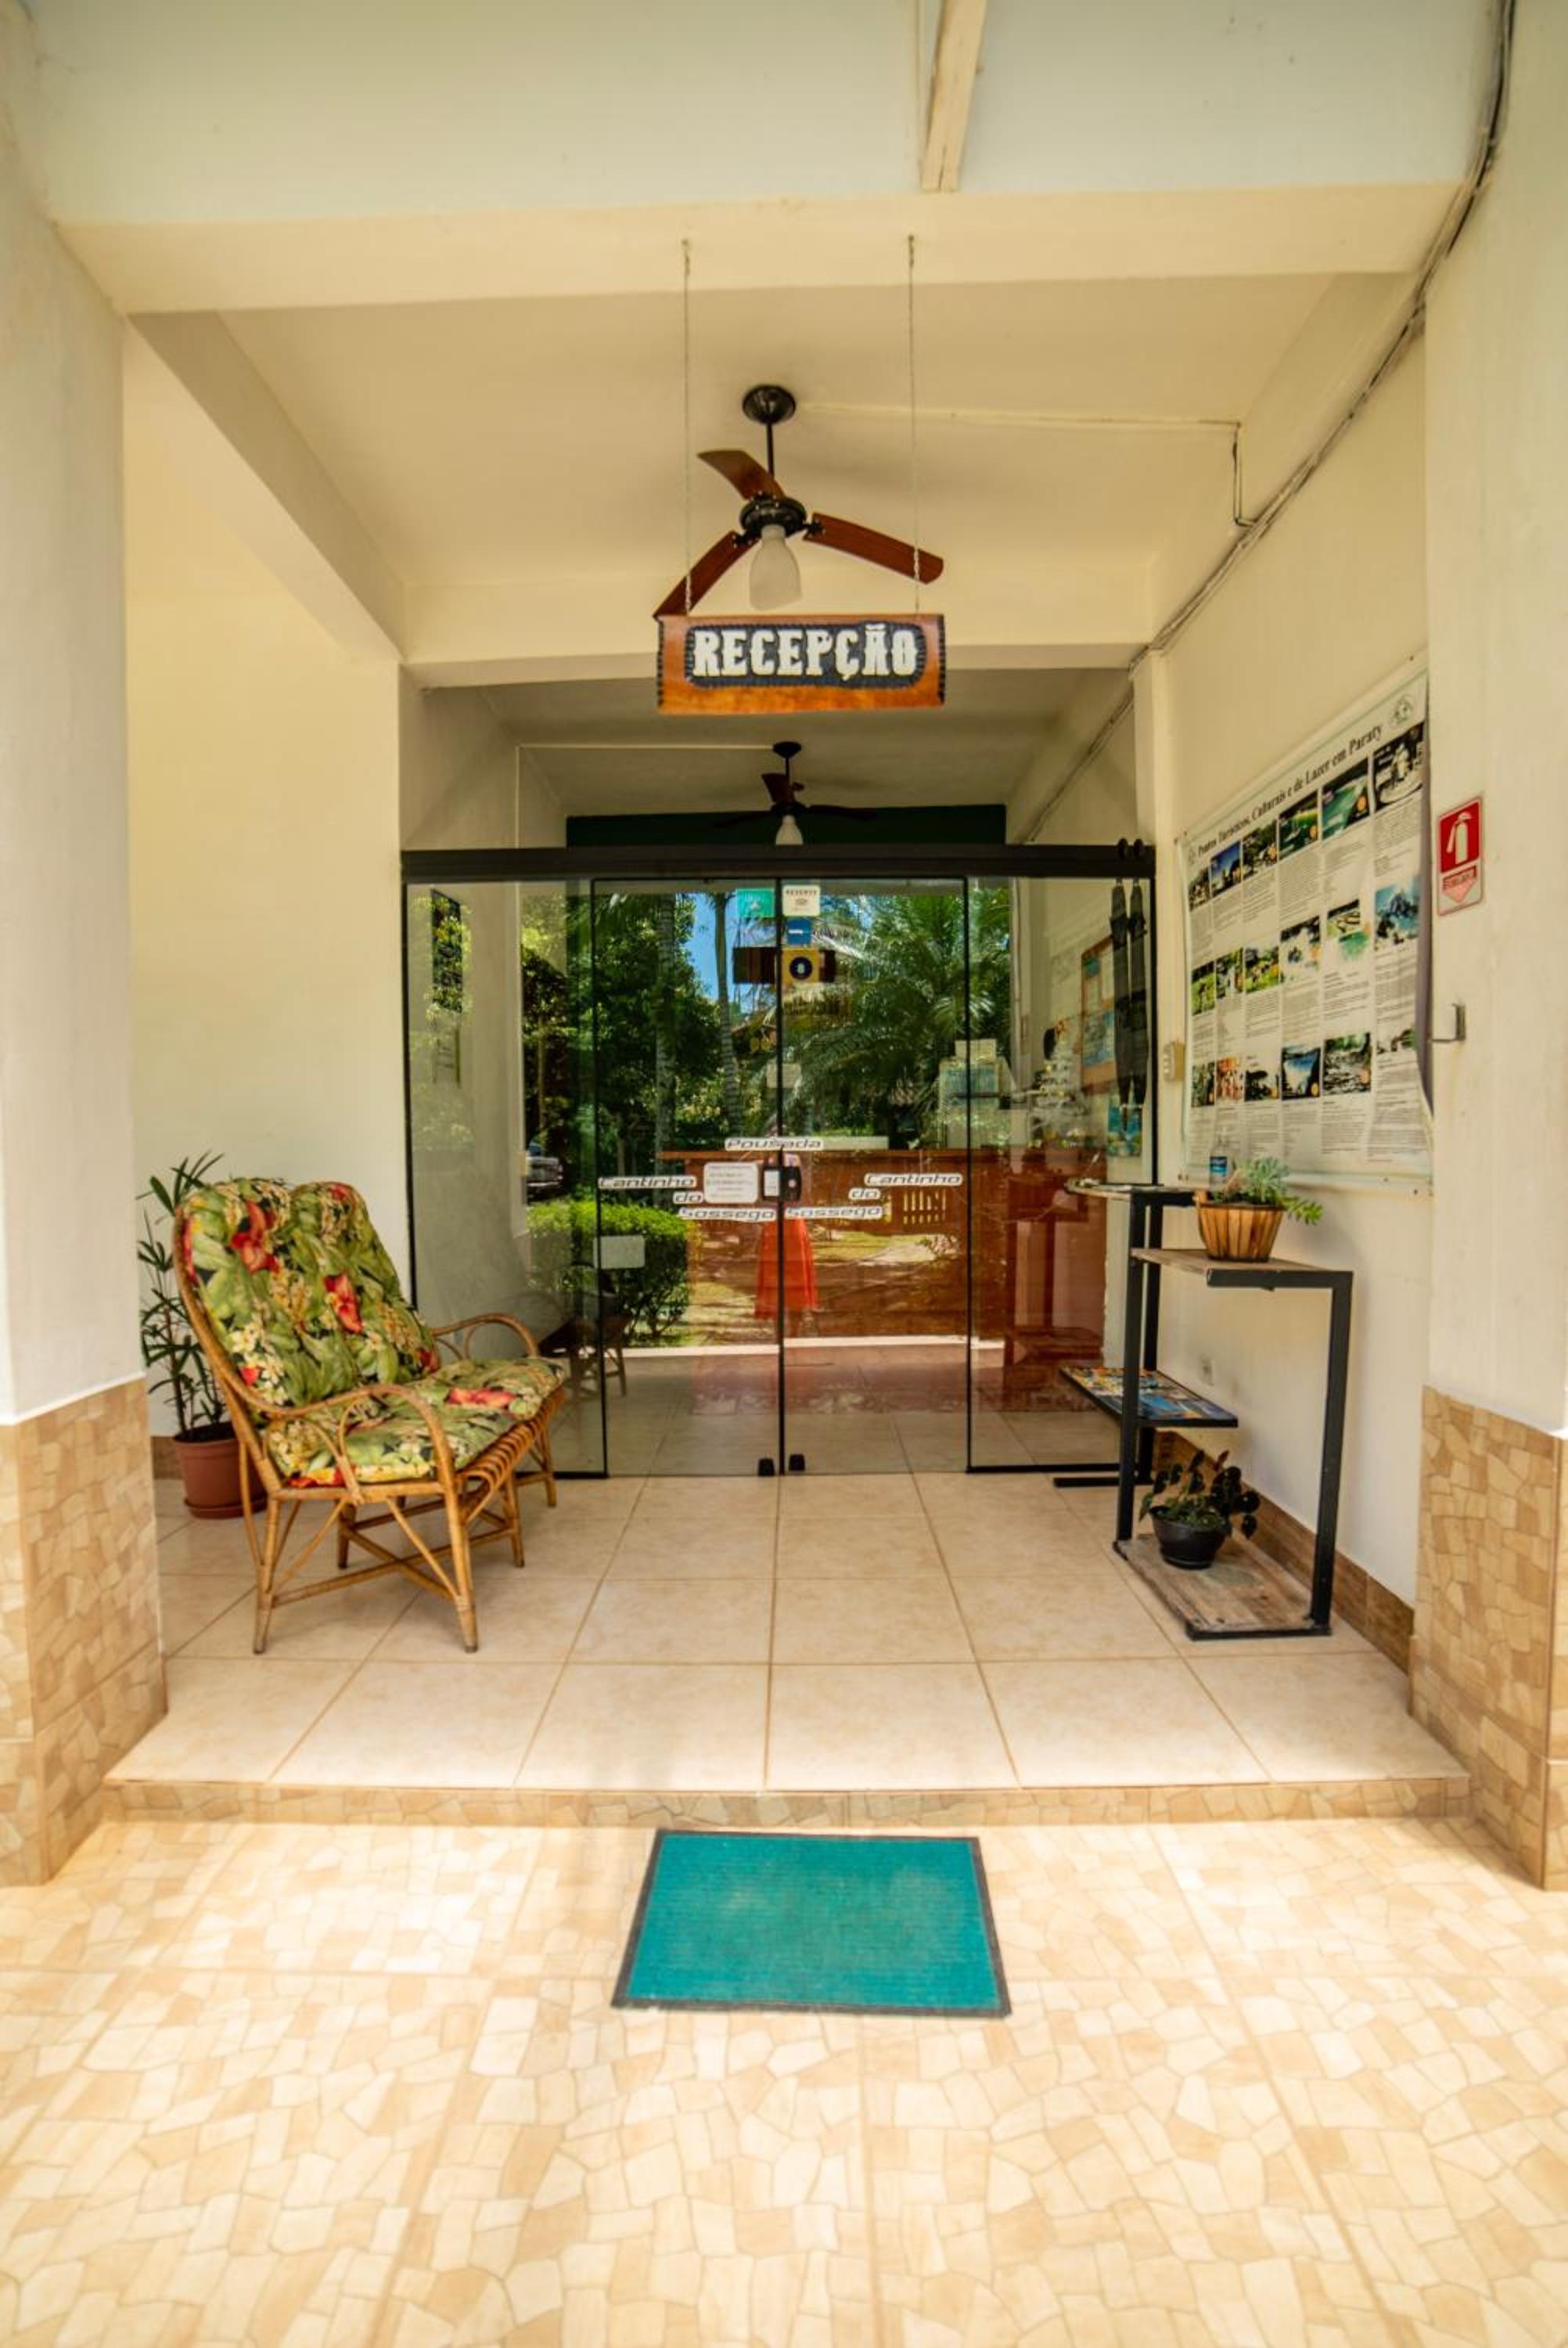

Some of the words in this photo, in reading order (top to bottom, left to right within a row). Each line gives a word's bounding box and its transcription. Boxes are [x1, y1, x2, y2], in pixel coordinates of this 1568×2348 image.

[692, 623, 918, 681] RECEPÇÃO
[1332, 749, 1346, 766] em
[1349, 726, 1381, 756] Paraty
[727, 1139, 822, 1150] Pousada
[599, 1176, 695, 1189] Cantinho
[866, 1174, 961, 1185] Cantinho
[675, 1194, 702, 1204] do
[851, 1190, 878, 1200] do
[680, 1208, 775, 1221] Sossego
[786, 1208, 880, 1219] Sossego
